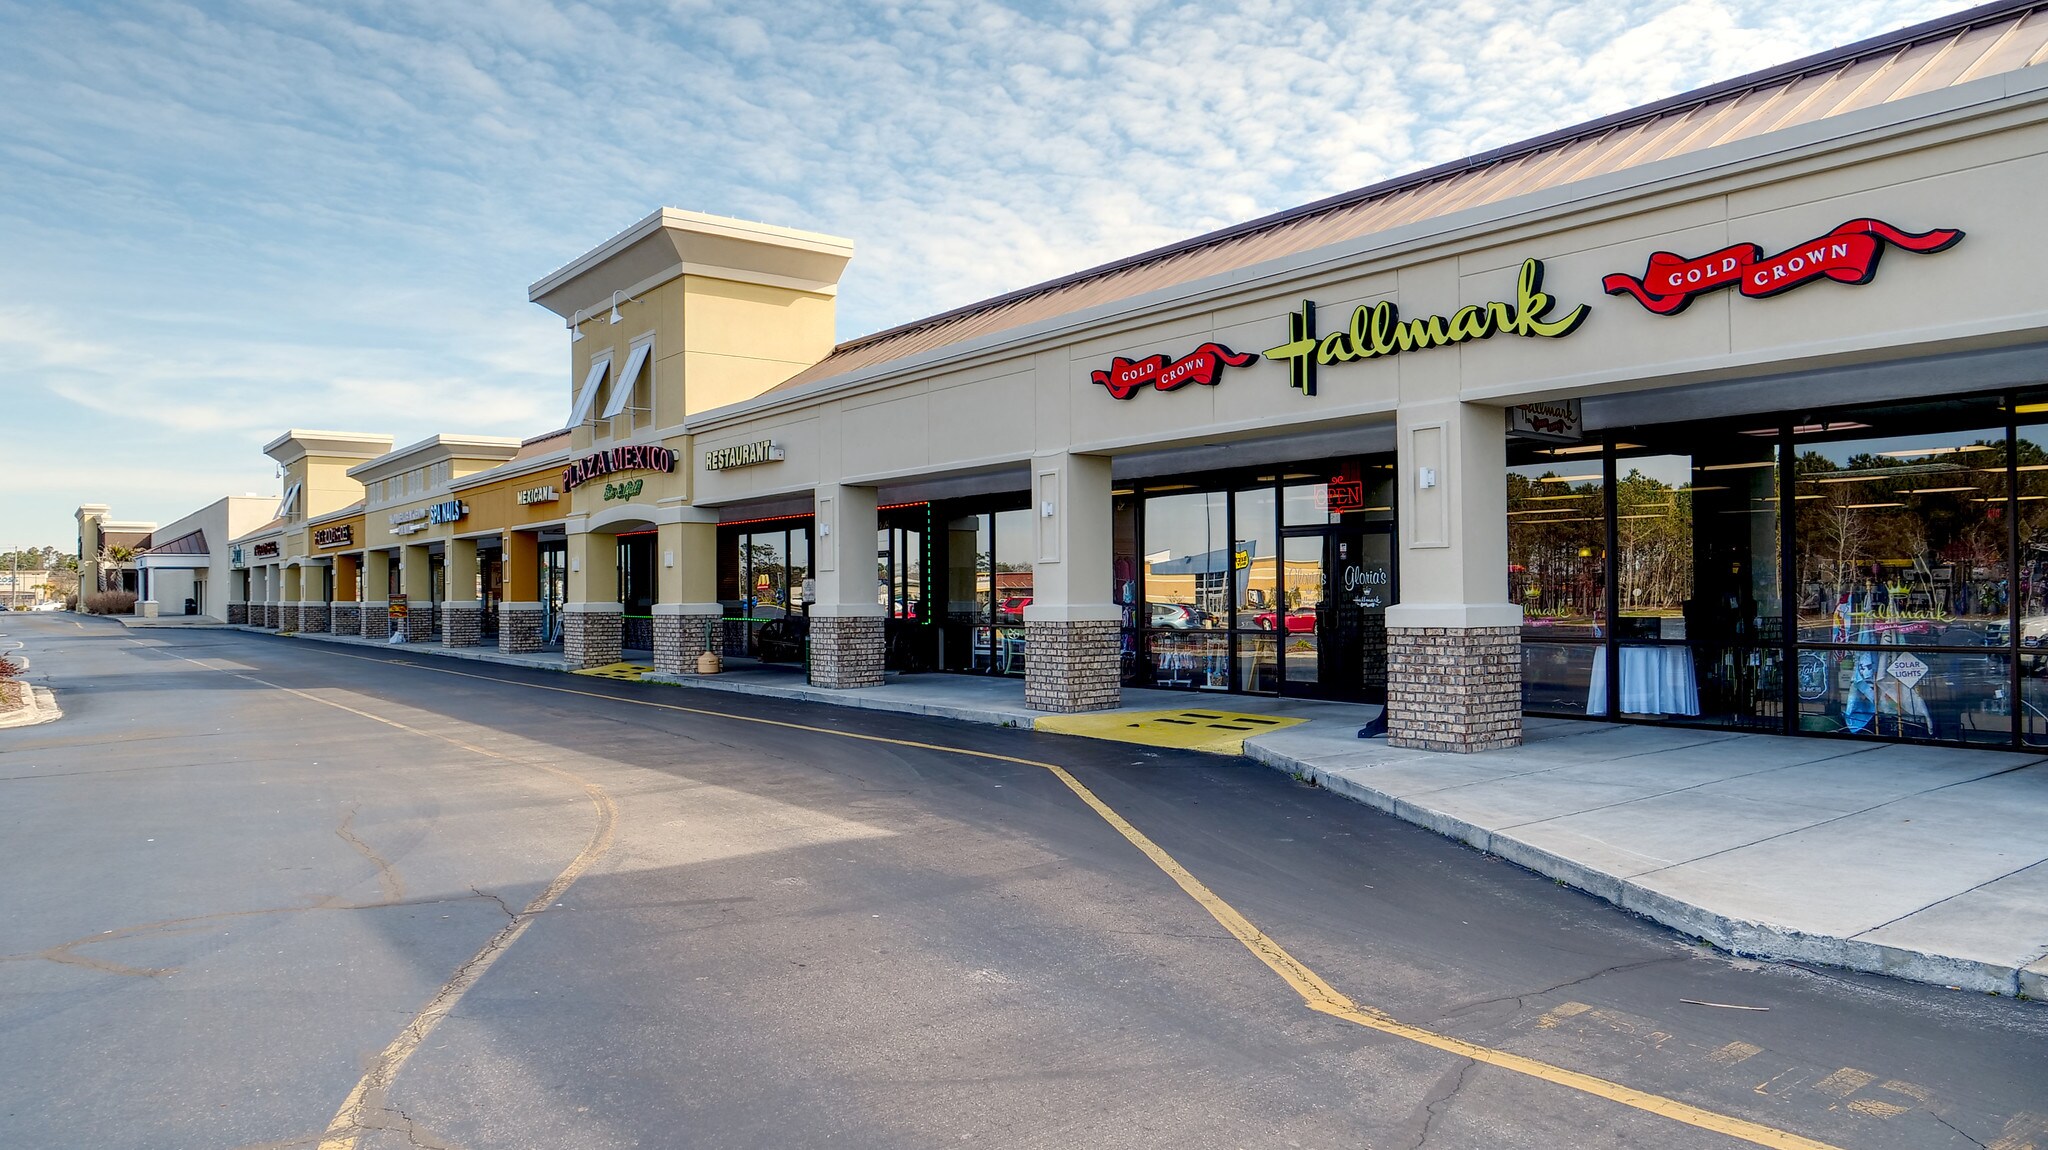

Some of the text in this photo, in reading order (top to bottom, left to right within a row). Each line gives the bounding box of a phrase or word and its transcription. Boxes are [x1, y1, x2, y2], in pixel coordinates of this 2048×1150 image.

[1668, 243, 1848, 287] GOLD CROWN
[1263, 258, 1589, 396] Hallmark
[1121, 358, 1204, 384] GOLD CROWN
[706, 440, 770, 470] RESTAURANT
[562, 445, 669, 491] PLAZA MEXICO
[517, 486, 550, 505] MEXICAN
[1316, 486, 1360, 505] OPEN
[430, 503, 442, 525] SPA
[442, 500, 460, 522] NAILS
[1344, 566, 1387, 591] Gloria's
[1847, 602, 1957, 625] Hallmark
[1894, 661, 1920, 669] SOLAR
